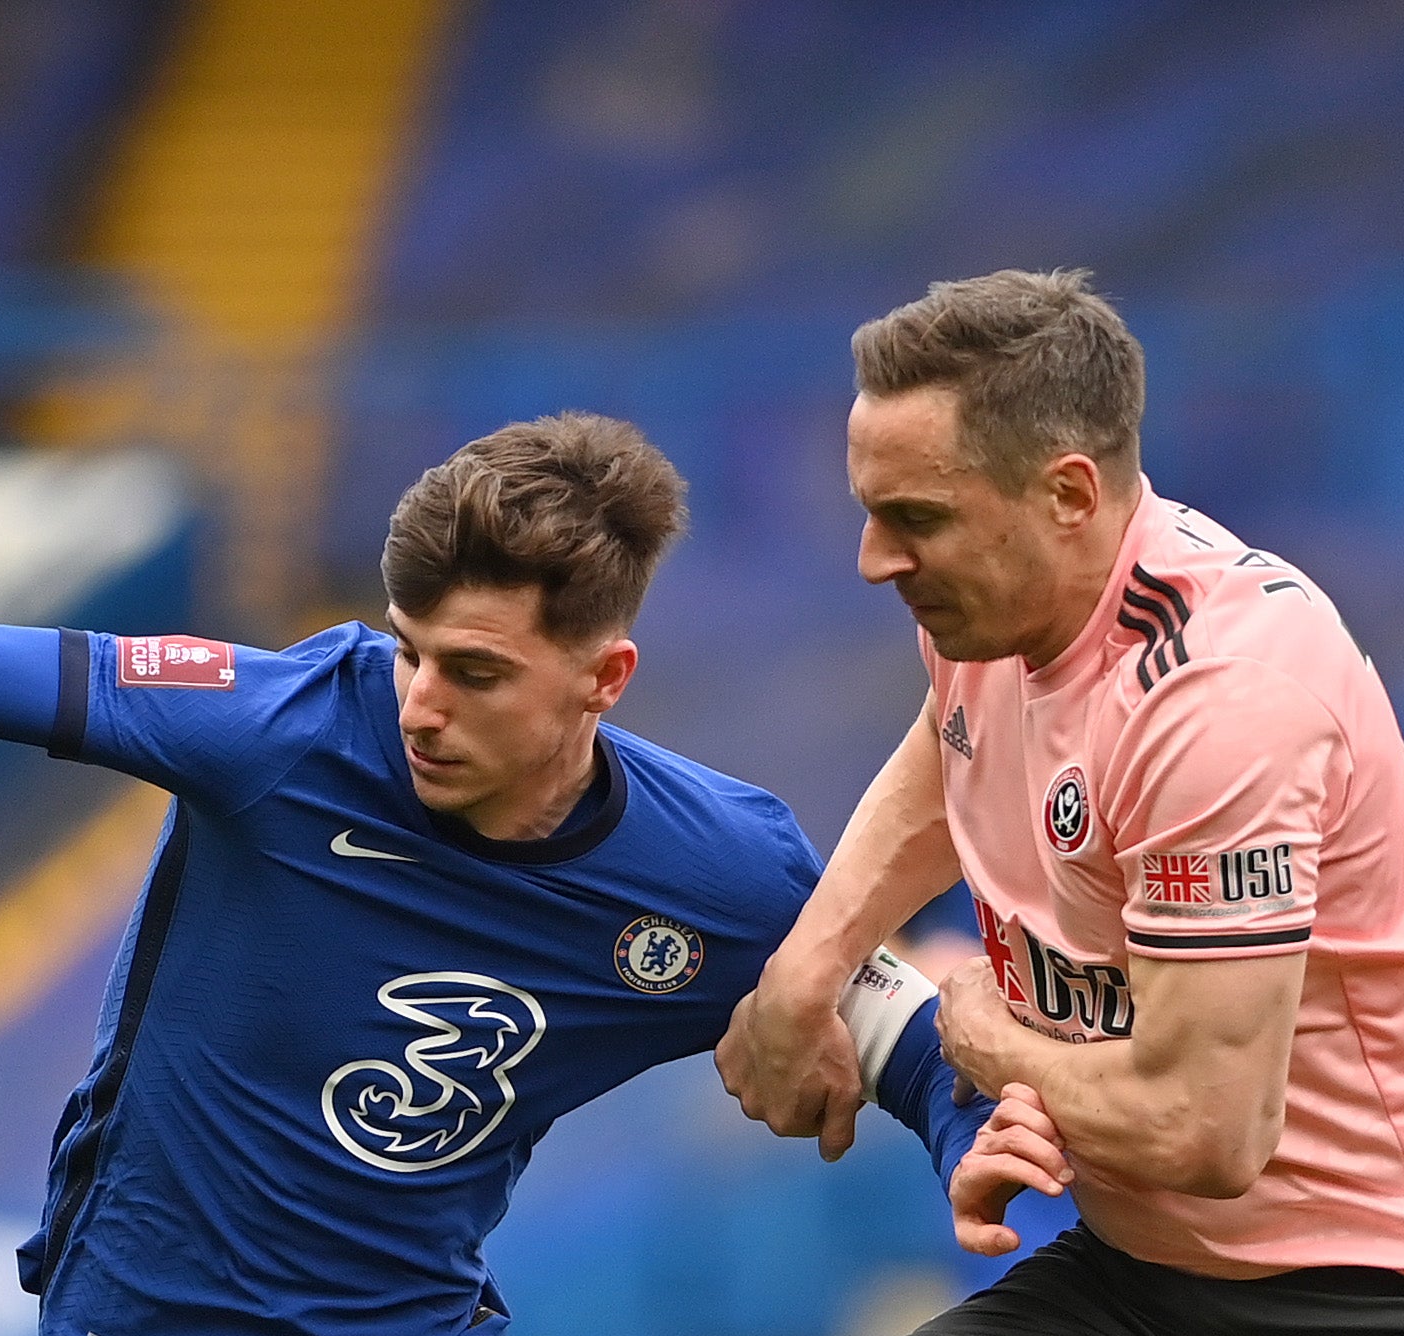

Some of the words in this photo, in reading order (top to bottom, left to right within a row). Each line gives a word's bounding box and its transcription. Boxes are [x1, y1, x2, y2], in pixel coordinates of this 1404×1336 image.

[131, 646, 147, 676] CUP
[1219, 843, 1293, 902] USG
[640, 916, 695, 942] CHELSEA
[621, 966, 654, 989] FOOTBALL
[657, 980, 678, 990] CLUB
